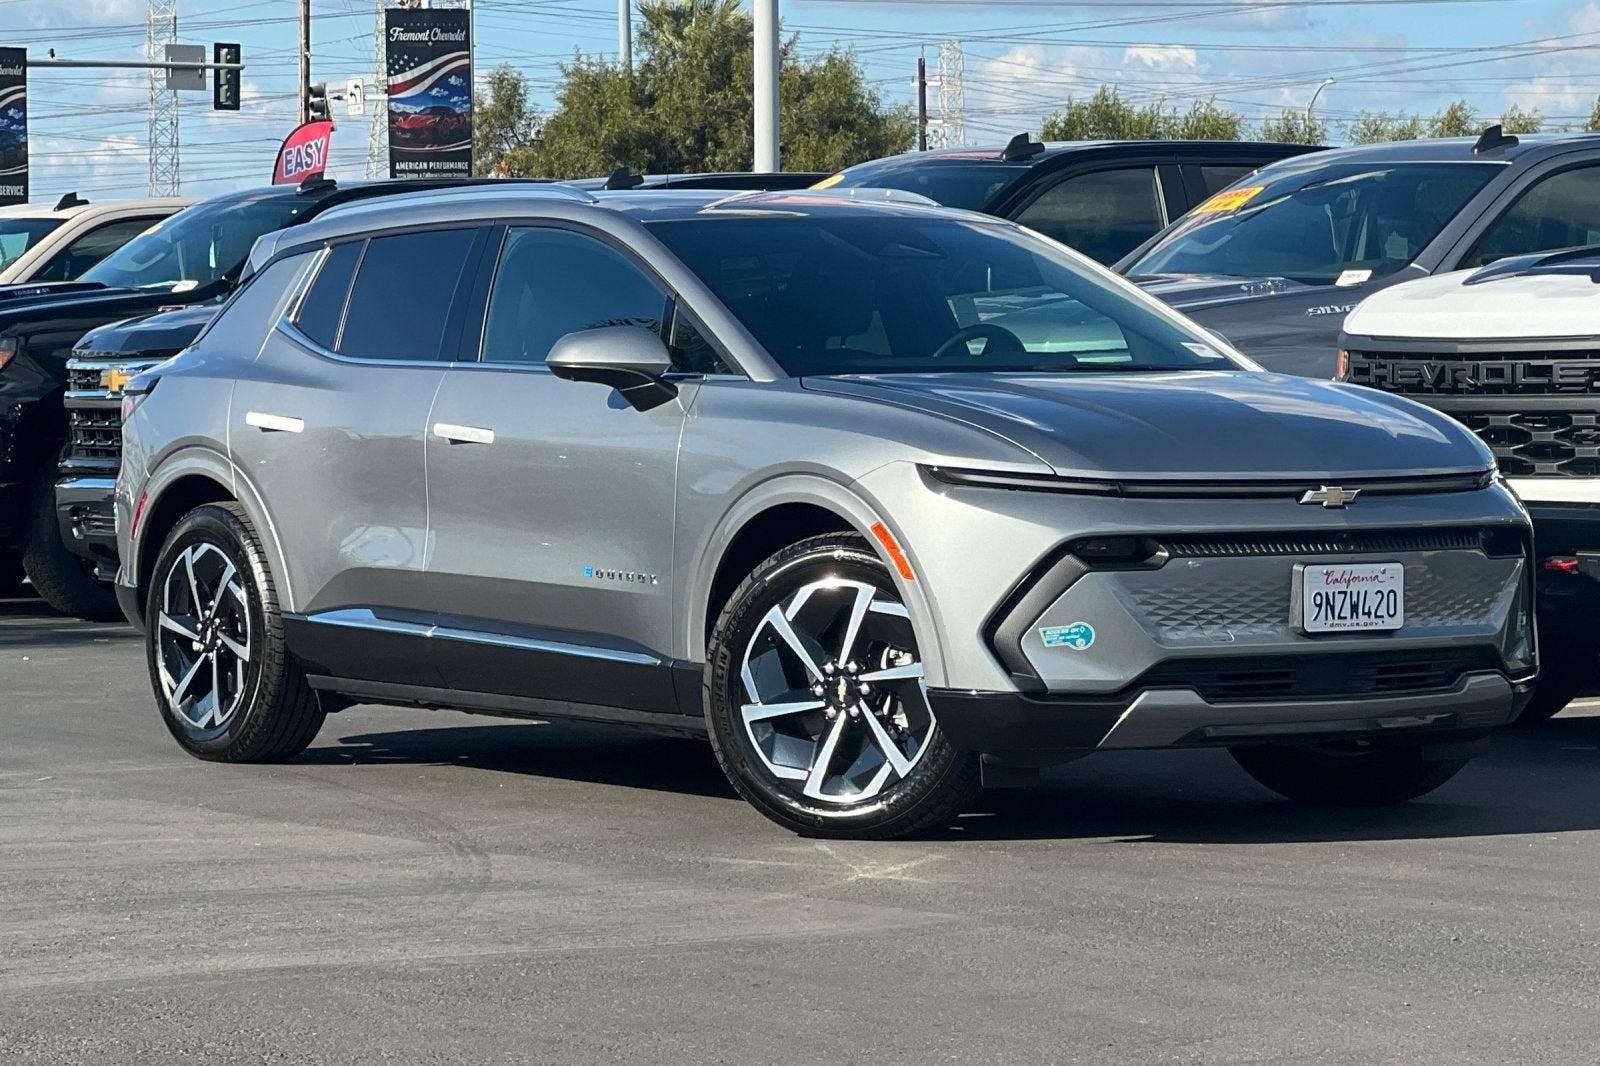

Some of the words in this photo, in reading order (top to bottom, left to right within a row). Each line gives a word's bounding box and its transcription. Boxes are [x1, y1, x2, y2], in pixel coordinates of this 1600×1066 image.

[389, 27, 430, 42] Fremont
[430, 27, 466, 41] Chevrolet
[284, 138, 325, 178] EASY
[395, 161, 428, 170] AMERICAN
[429, 161, 469, 170] PERFORMANCE
[1349, 361, 1592, 387] CHEVROLE
[583, 565, 658, 585] EQUINOX
[1324, 570, 1386, 589] California
[1312, 589, 1397, 621] 9NZW420
[1329, 620, 1380, 628] dmv.ca.gov
[713, 653, 730, 739] MICHELIN
